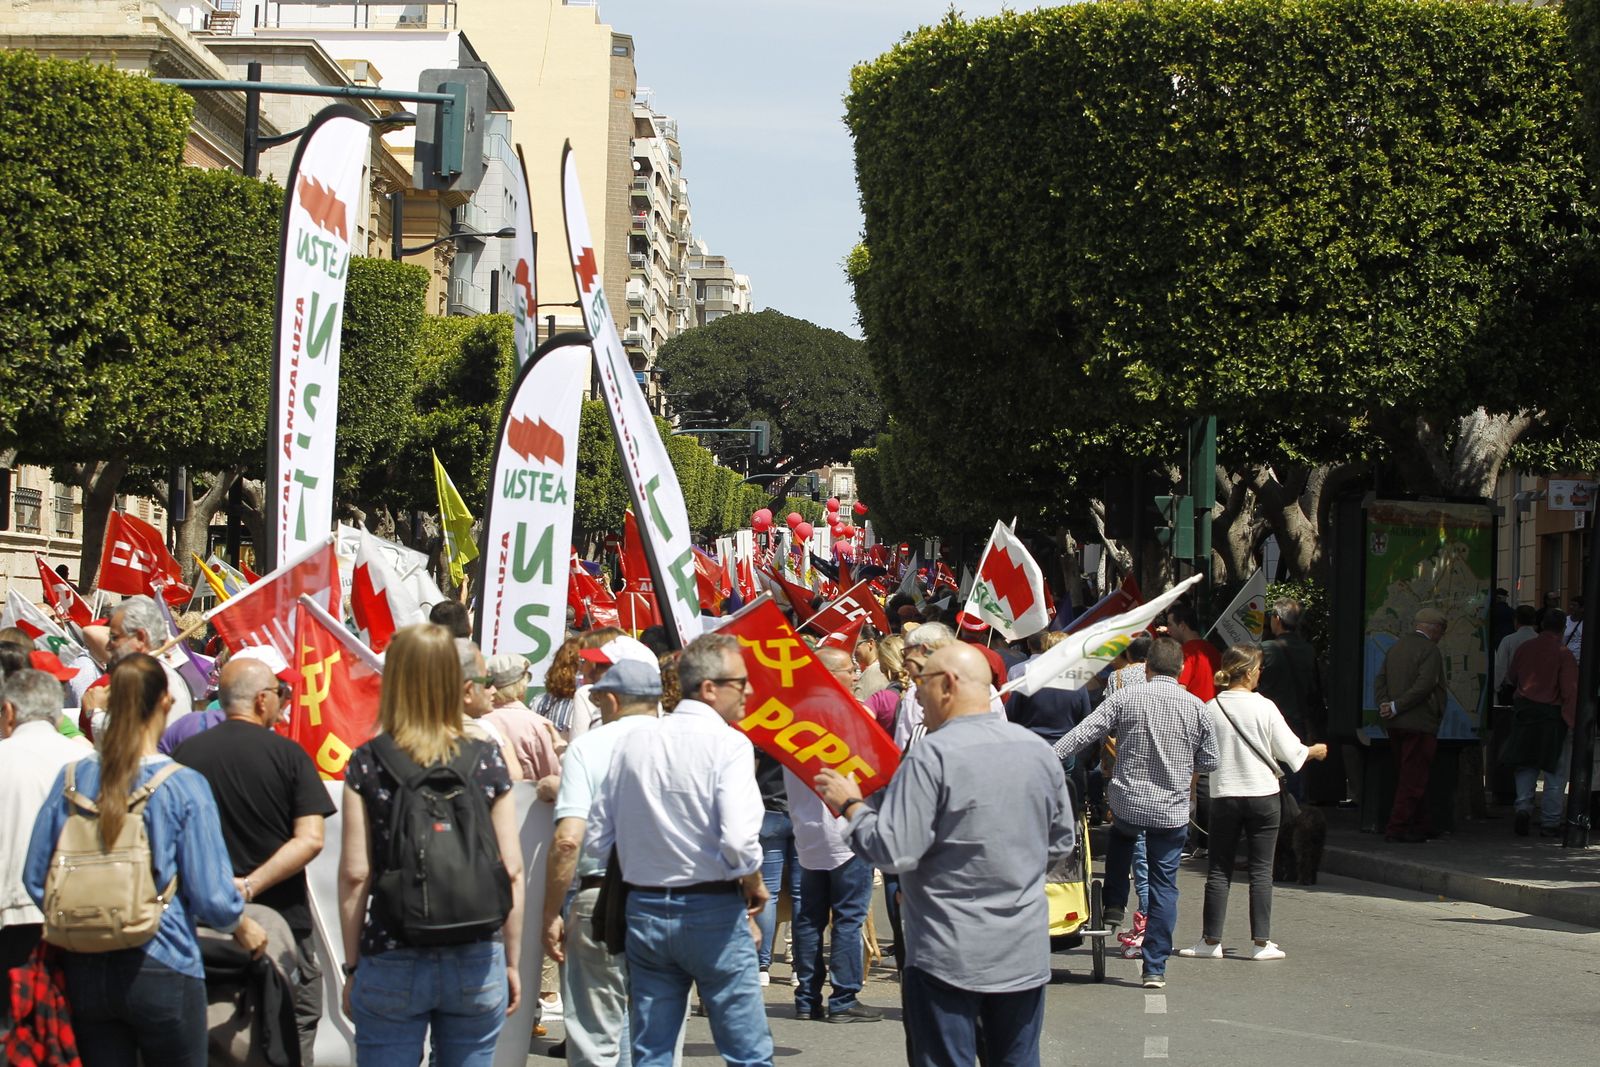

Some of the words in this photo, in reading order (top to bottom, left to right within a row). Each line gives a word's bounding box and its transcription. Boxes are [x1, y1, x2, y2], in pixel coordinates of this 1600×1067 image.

[282, 297, 305, 460] ANDALUZA
[502, 468, 568, 505] USTEA
[738, 696, 877, 784] PCPE
